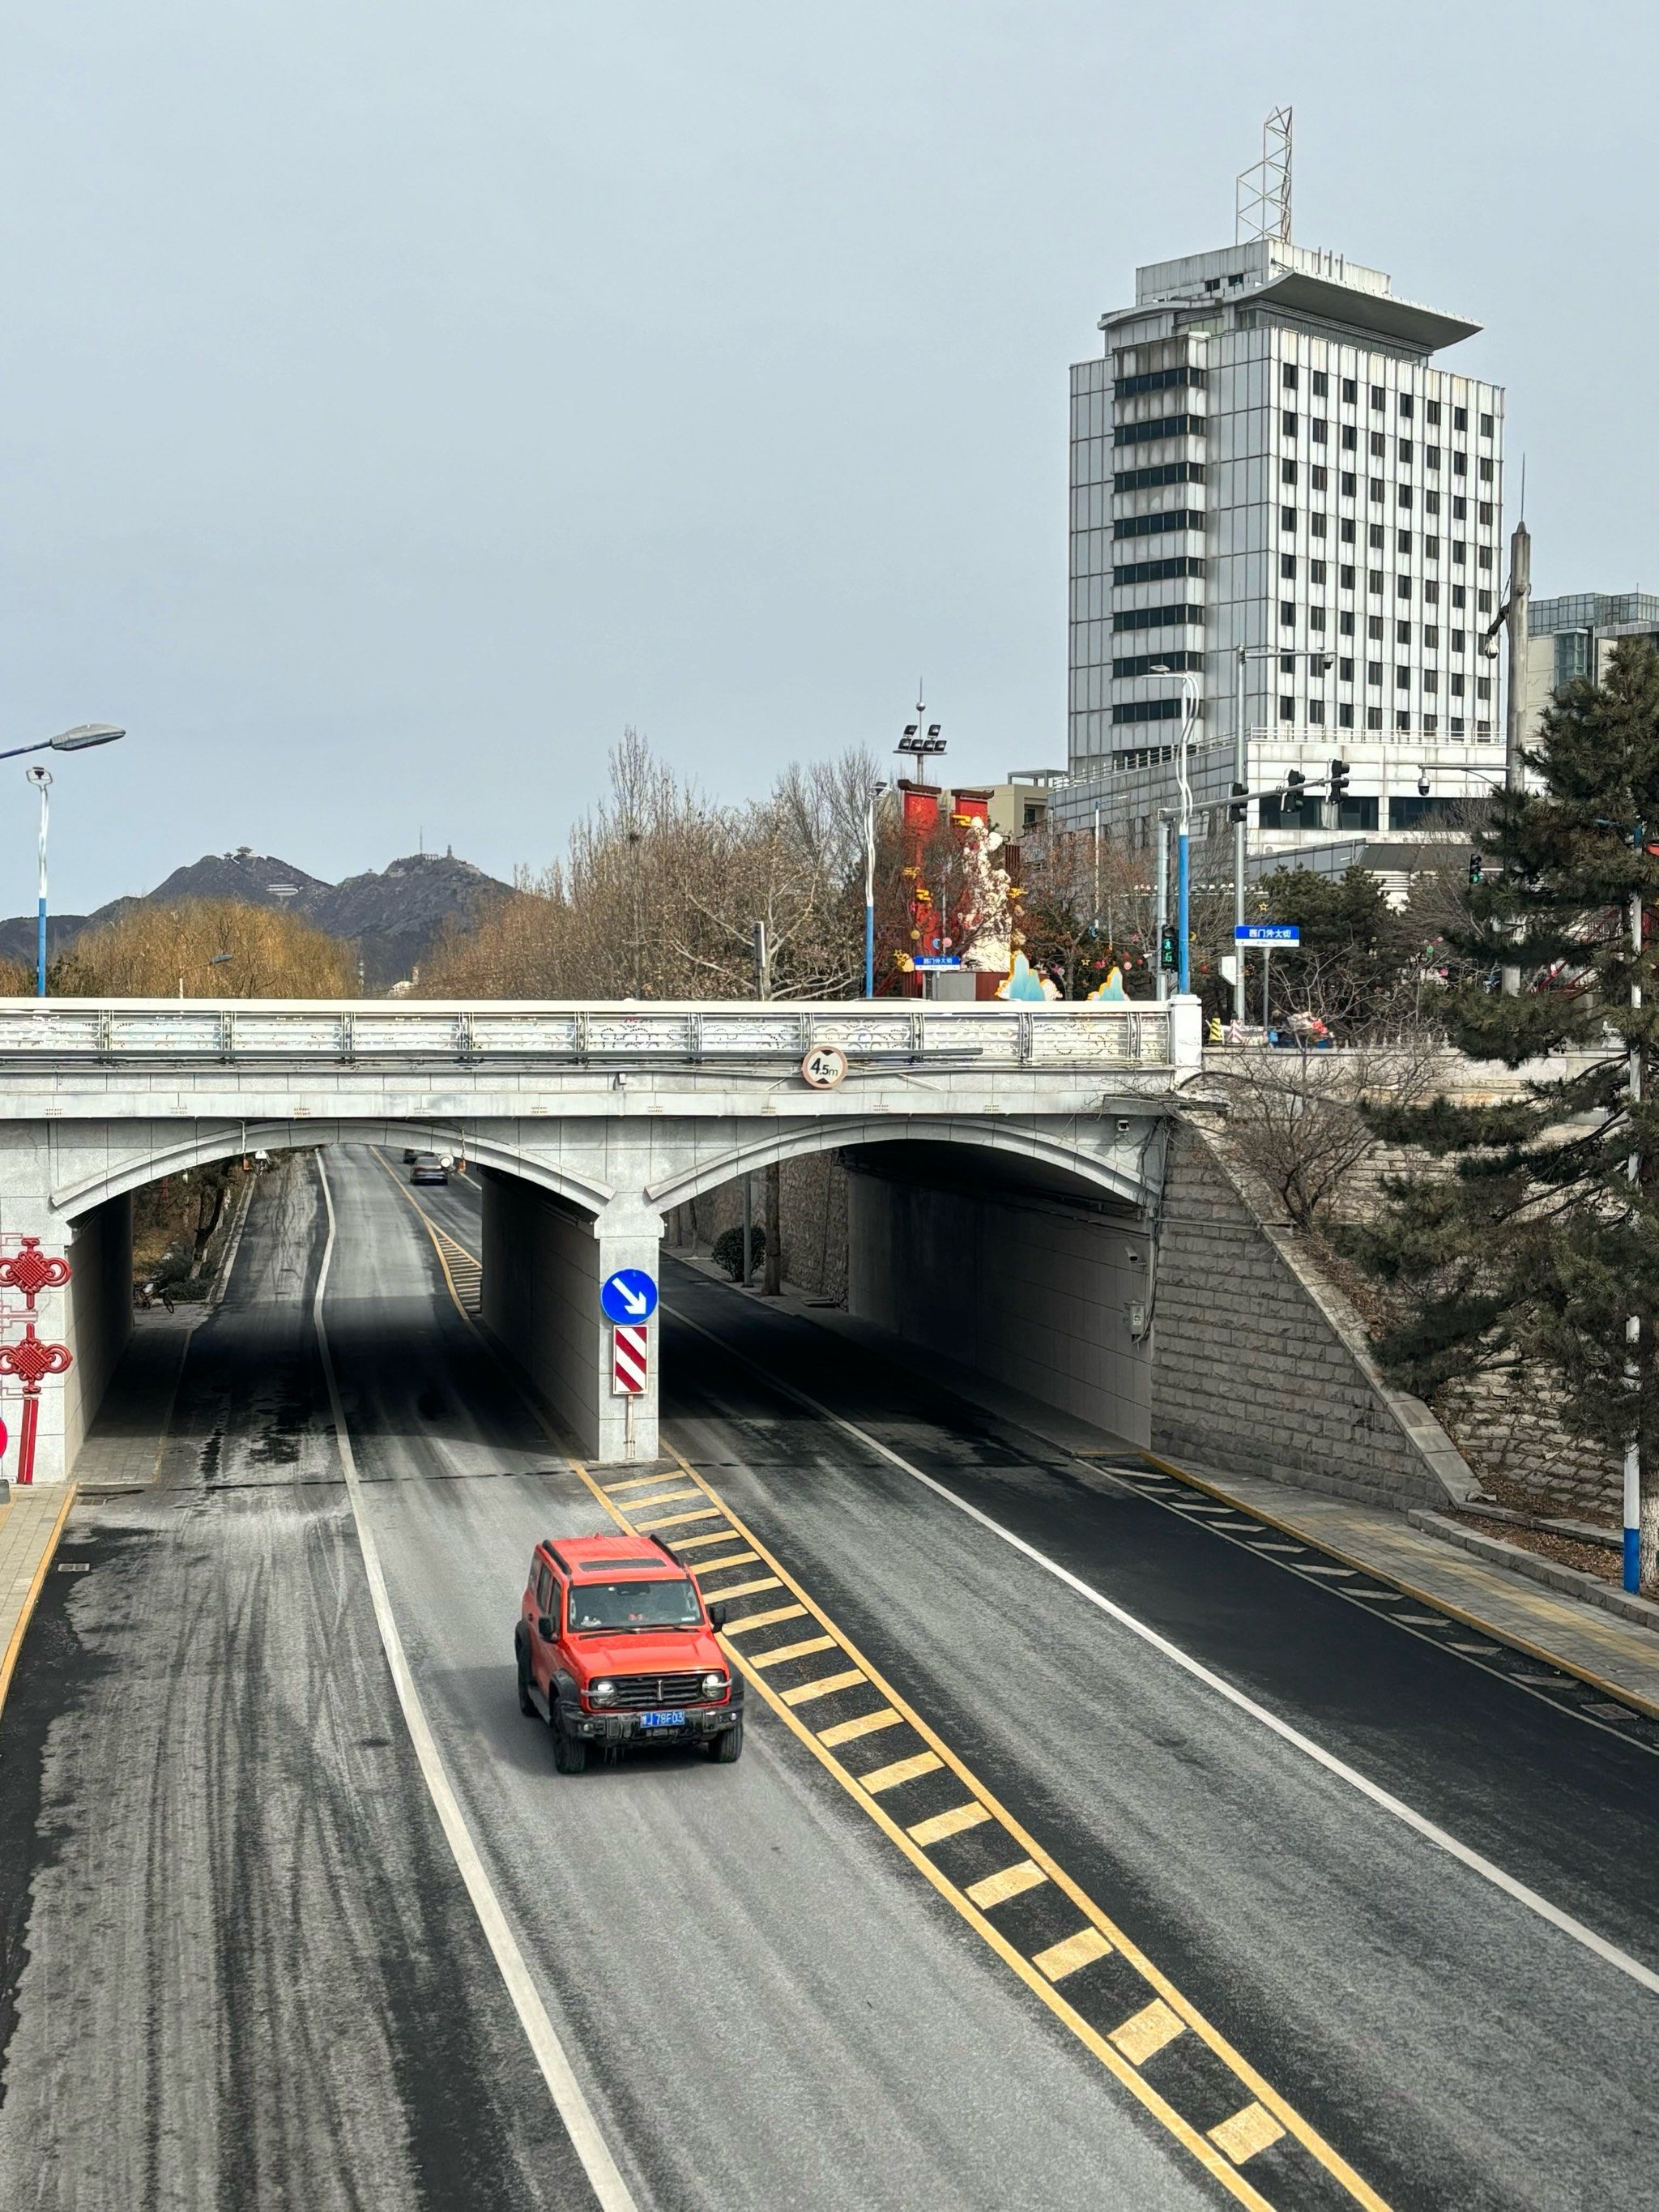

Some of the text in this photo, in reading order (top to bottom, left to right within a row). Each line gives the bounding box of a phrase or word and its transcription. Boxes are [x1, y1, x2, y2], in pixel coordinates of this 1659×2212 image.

[1248, 929, 1292, 938] 西门外大街
[809, 1057, 839, 1076] 4.5m
